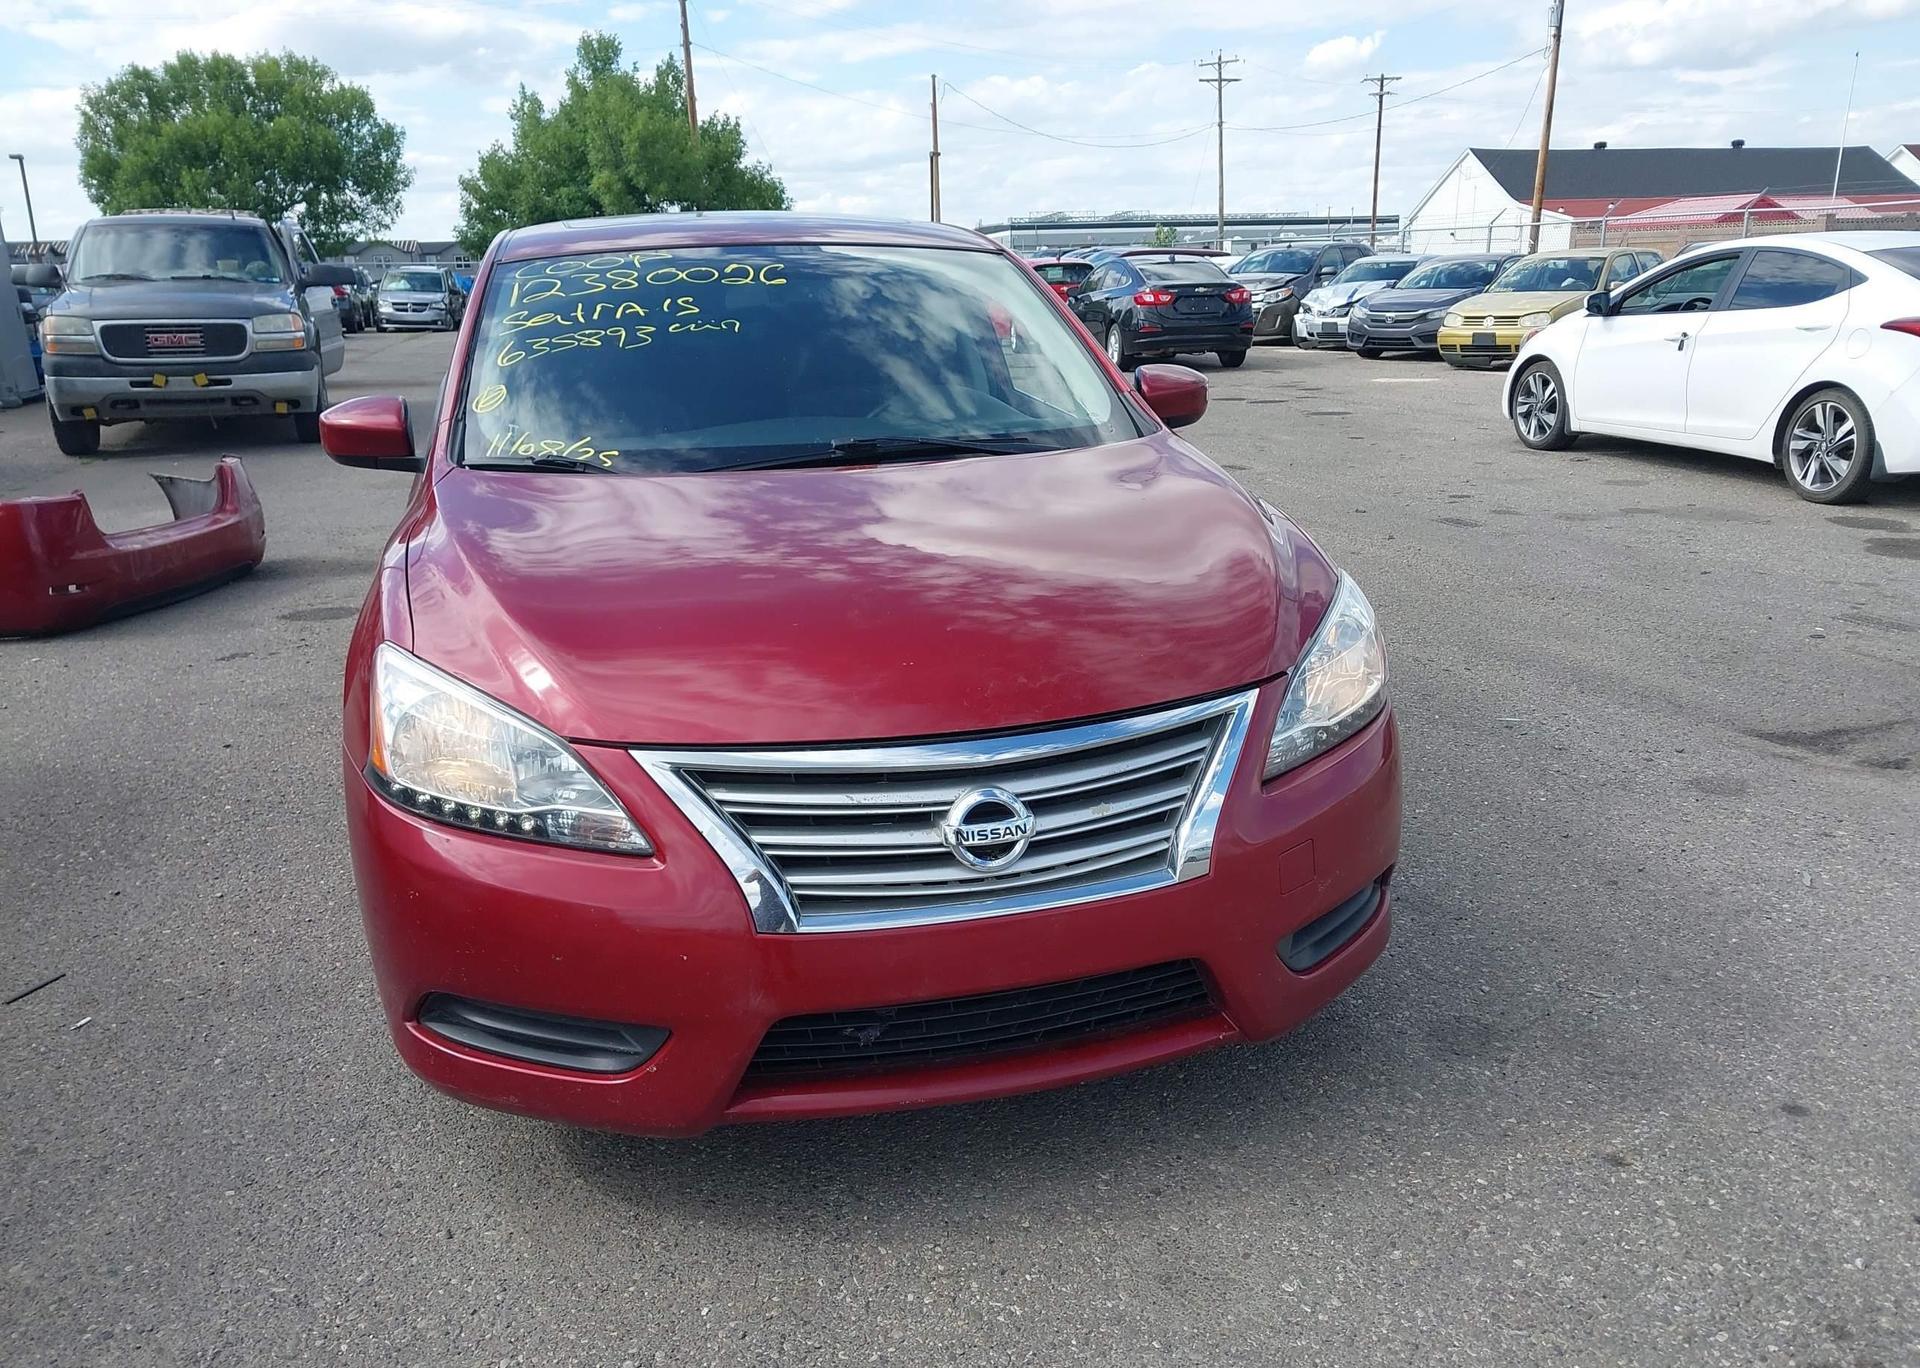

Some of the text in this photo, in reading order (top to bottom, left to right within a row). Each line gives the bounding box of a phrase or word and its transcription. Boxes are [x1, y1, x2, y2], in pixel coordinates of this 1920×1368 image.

[510, 263, 788, 308] 12380026
[149, 334, 201, 347] GMC
[496, 326, 657, 368] 635893
[954, 823, 1028, 843] NISSAN
